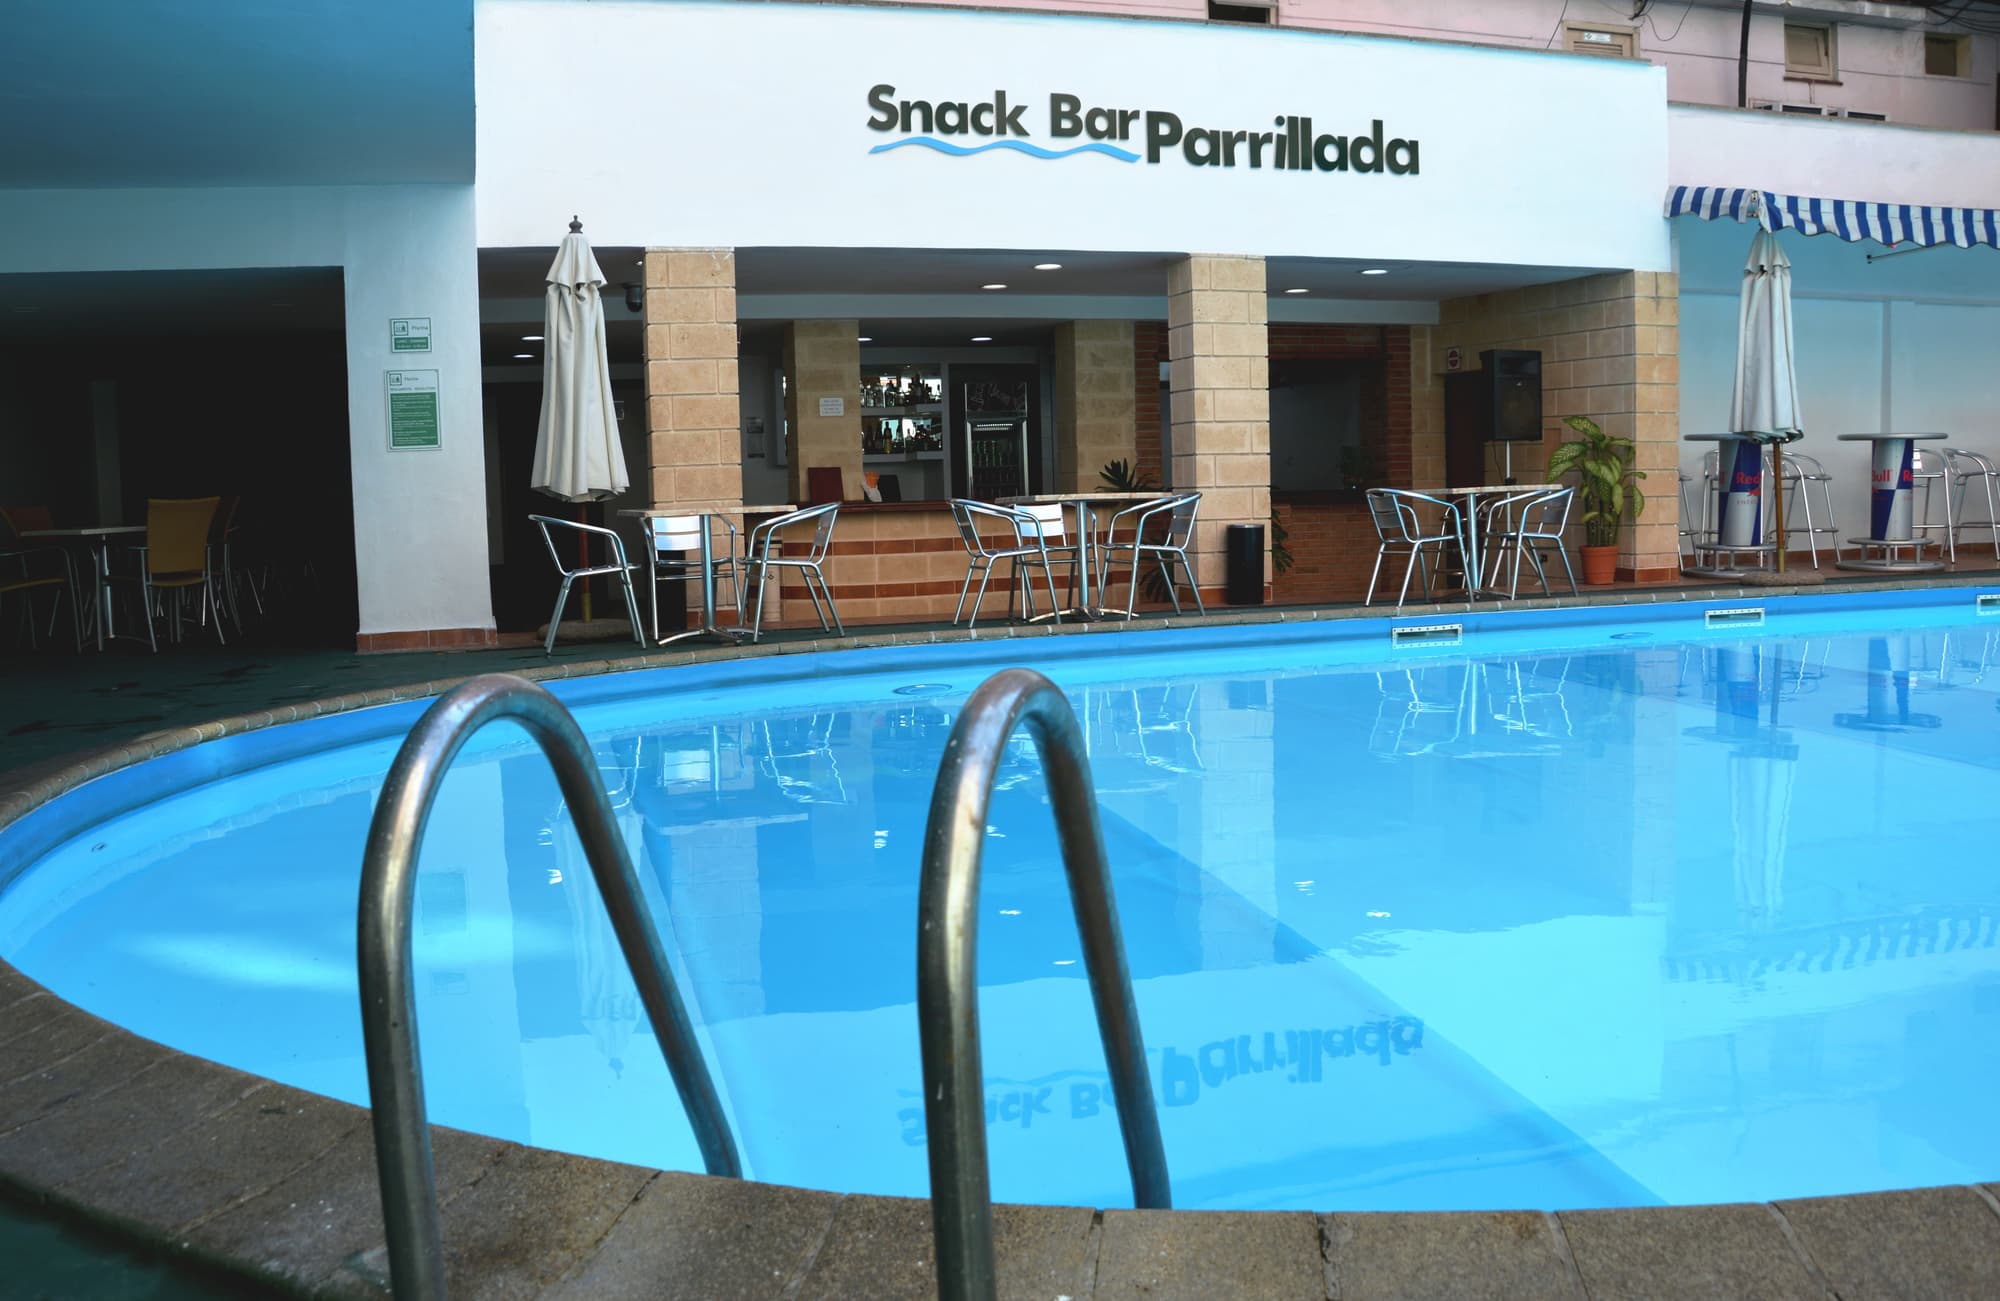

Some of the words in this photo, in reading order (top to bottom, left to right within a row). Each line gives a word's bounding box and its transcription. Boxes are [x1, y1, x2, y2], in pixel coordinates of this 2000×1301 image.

[867, 84, 1030, 137] Snack
[1050, 92, 1141, 141] Bar
[1146, 111, 1420, 175] Parrillada
[1736, 471, 1761, 484] Red
